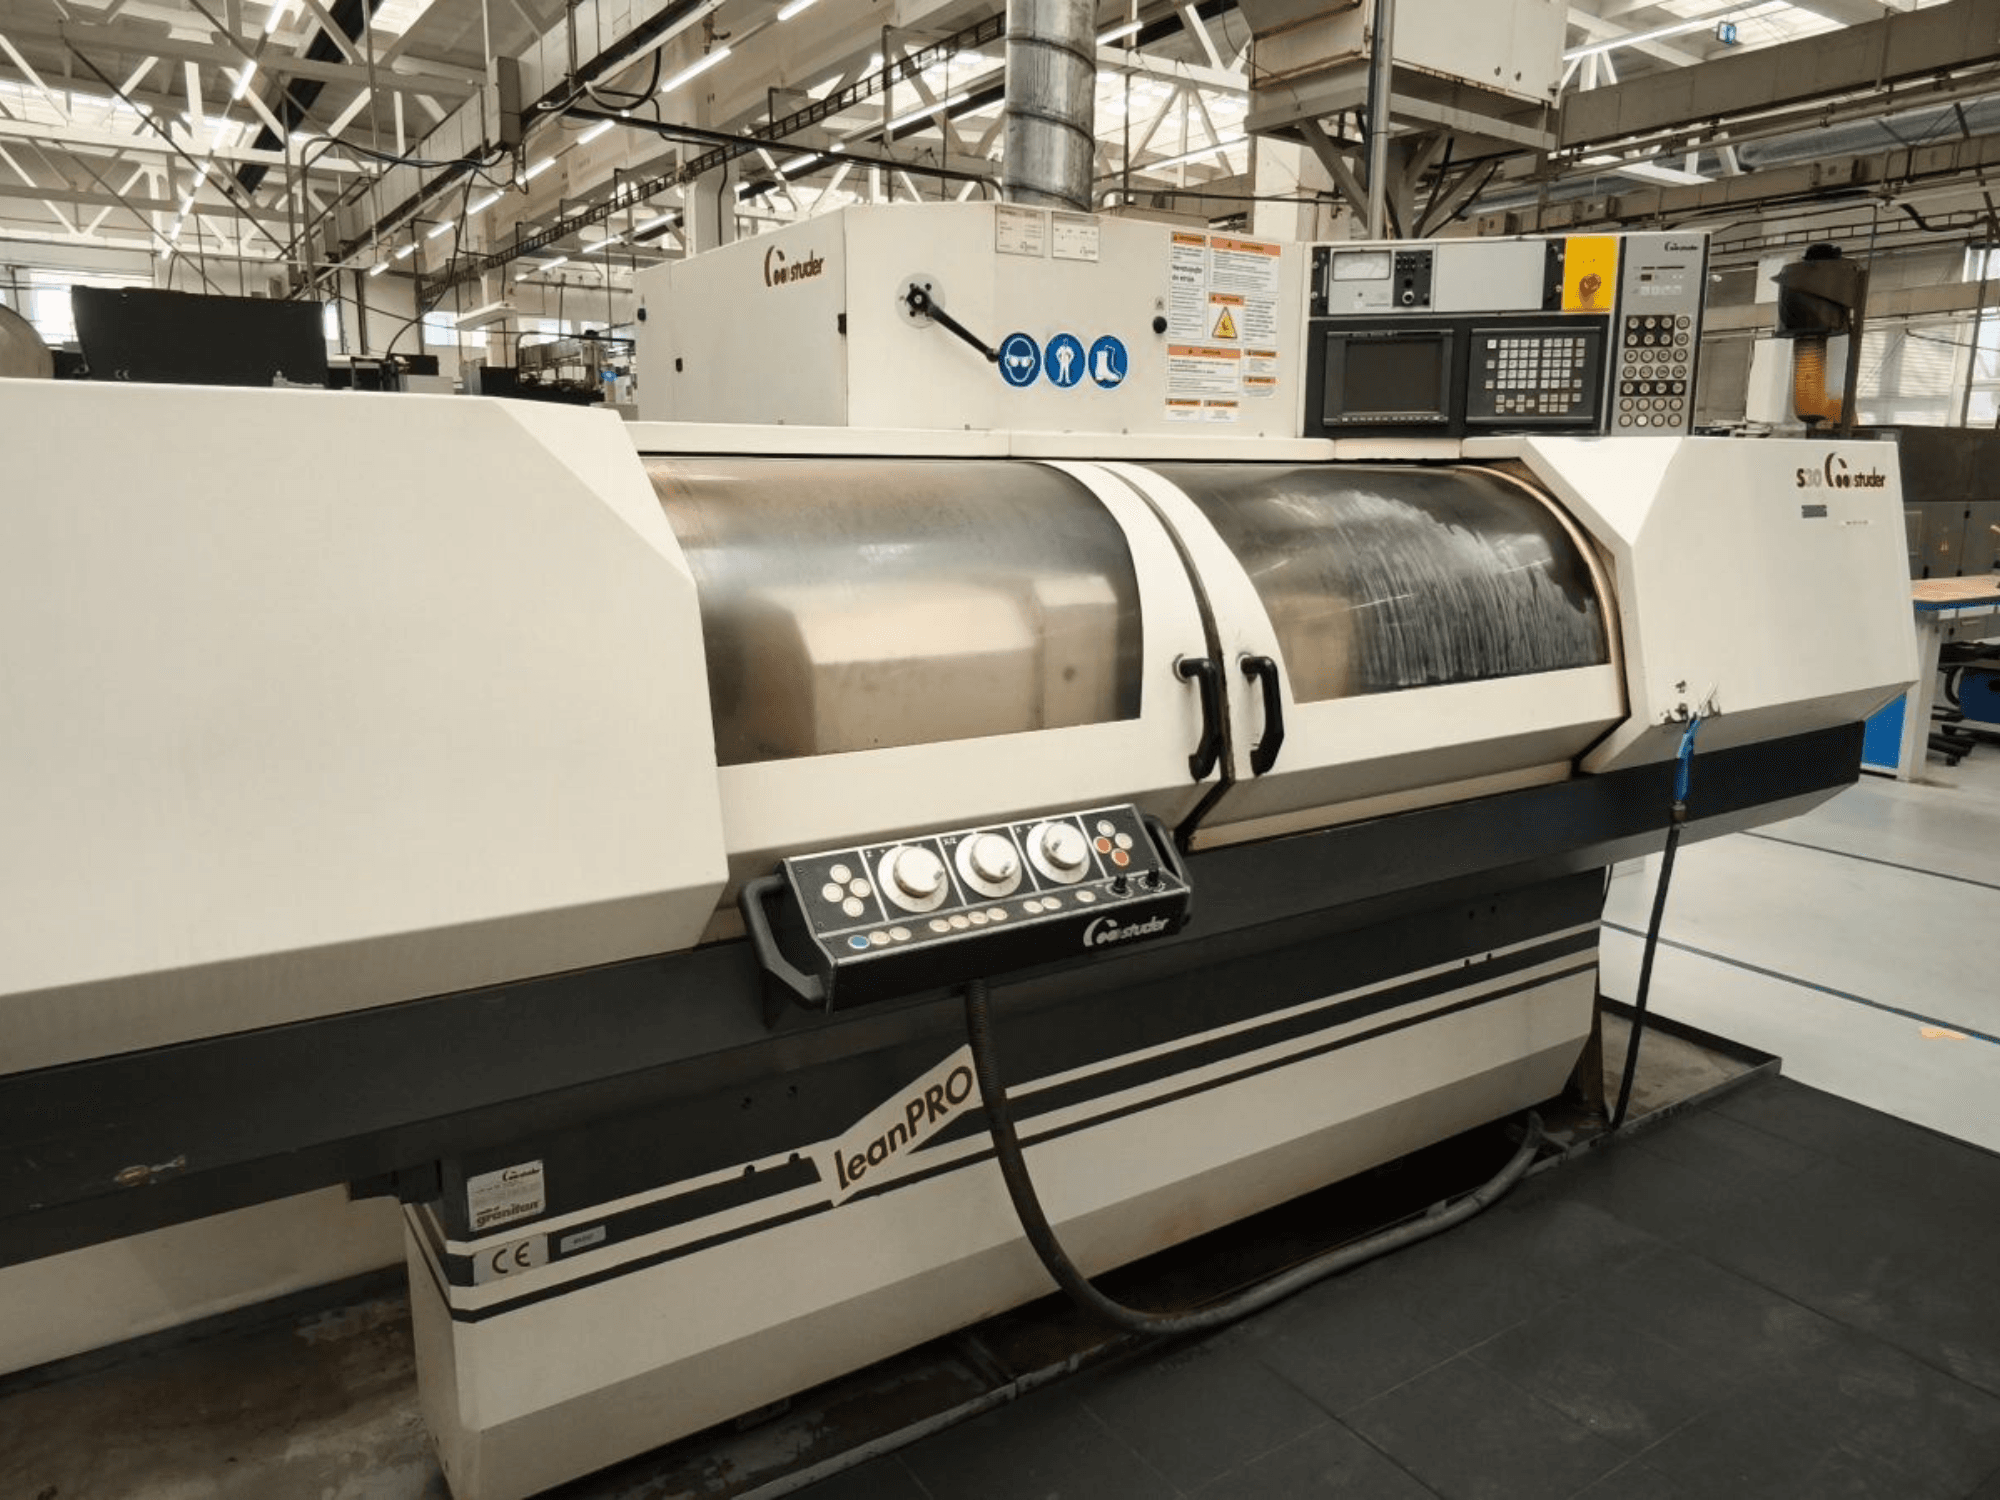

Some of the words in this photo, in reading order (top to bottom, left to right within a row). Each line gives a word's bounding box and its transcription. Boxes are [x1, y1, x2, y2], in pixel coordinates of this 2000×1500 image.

[790, 249, 825, 282] studer
[1796, 467, 1822, 488] S30
[1854, 466, 1885, 487] studer
[1120, 916, 1169, 939] studer
[835, 1066, 972, 1190] leanPRO
[492, 1242, 531, 1274] CE
